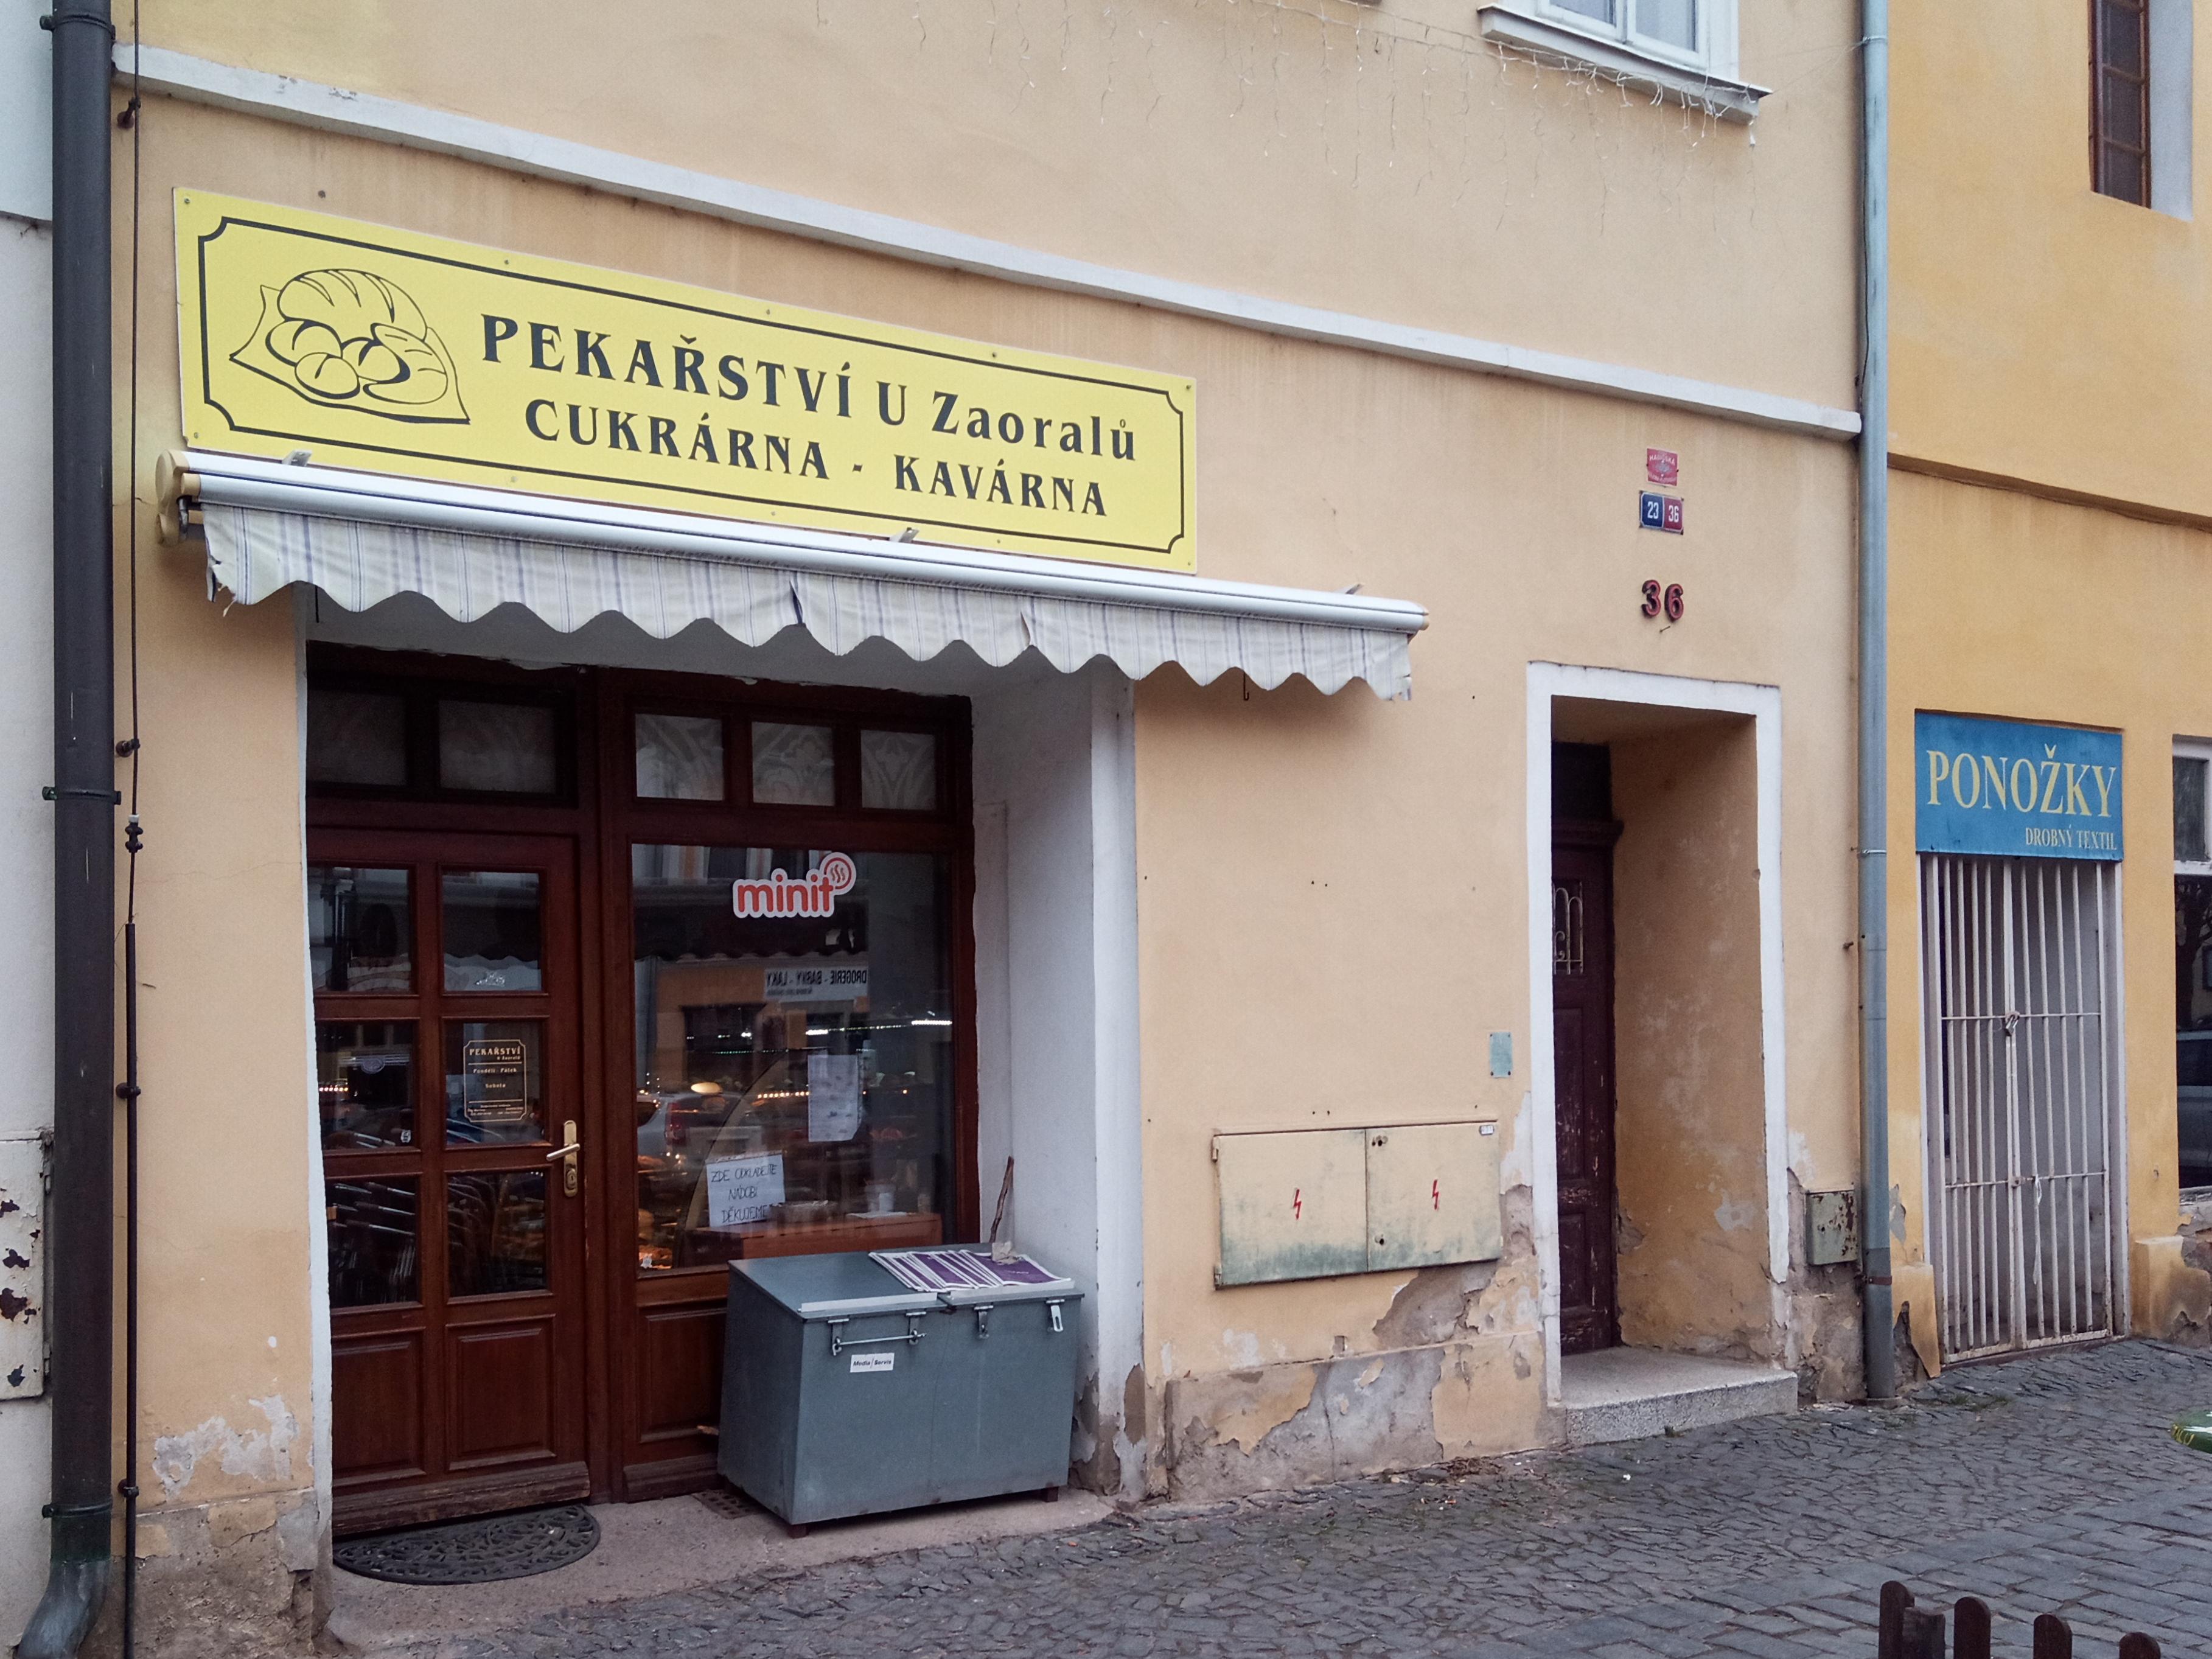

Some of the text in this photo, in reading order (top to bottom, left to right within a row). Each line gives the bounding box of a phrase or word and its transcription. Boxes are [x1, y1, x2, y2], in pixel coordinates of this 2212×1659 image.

[481, 314, 1135, 461] PEKAŘSTVÍ U Zaoralů
[525, 399, 829, 480] CUKRÁRNA
[895, 455, 1106, 516] KAVÁRNA
[1647, 501, 1659, 519] 23
[1668, 505, 1680, 522] 36
[1641, 579, 1684, 622] 36
[1926, 743, 2116, 817] PONOŽKY
[2025, 824, 2117, 851] DROBNÝ TEXTIL
[737, 874, 834, 913] minit
[469, 1046, 520, 1056] PEKAŘSTVÍ
[711, 1170, 730, 1182] ZDE
[721, 1205, 768, 1223] DĚKUJEME
